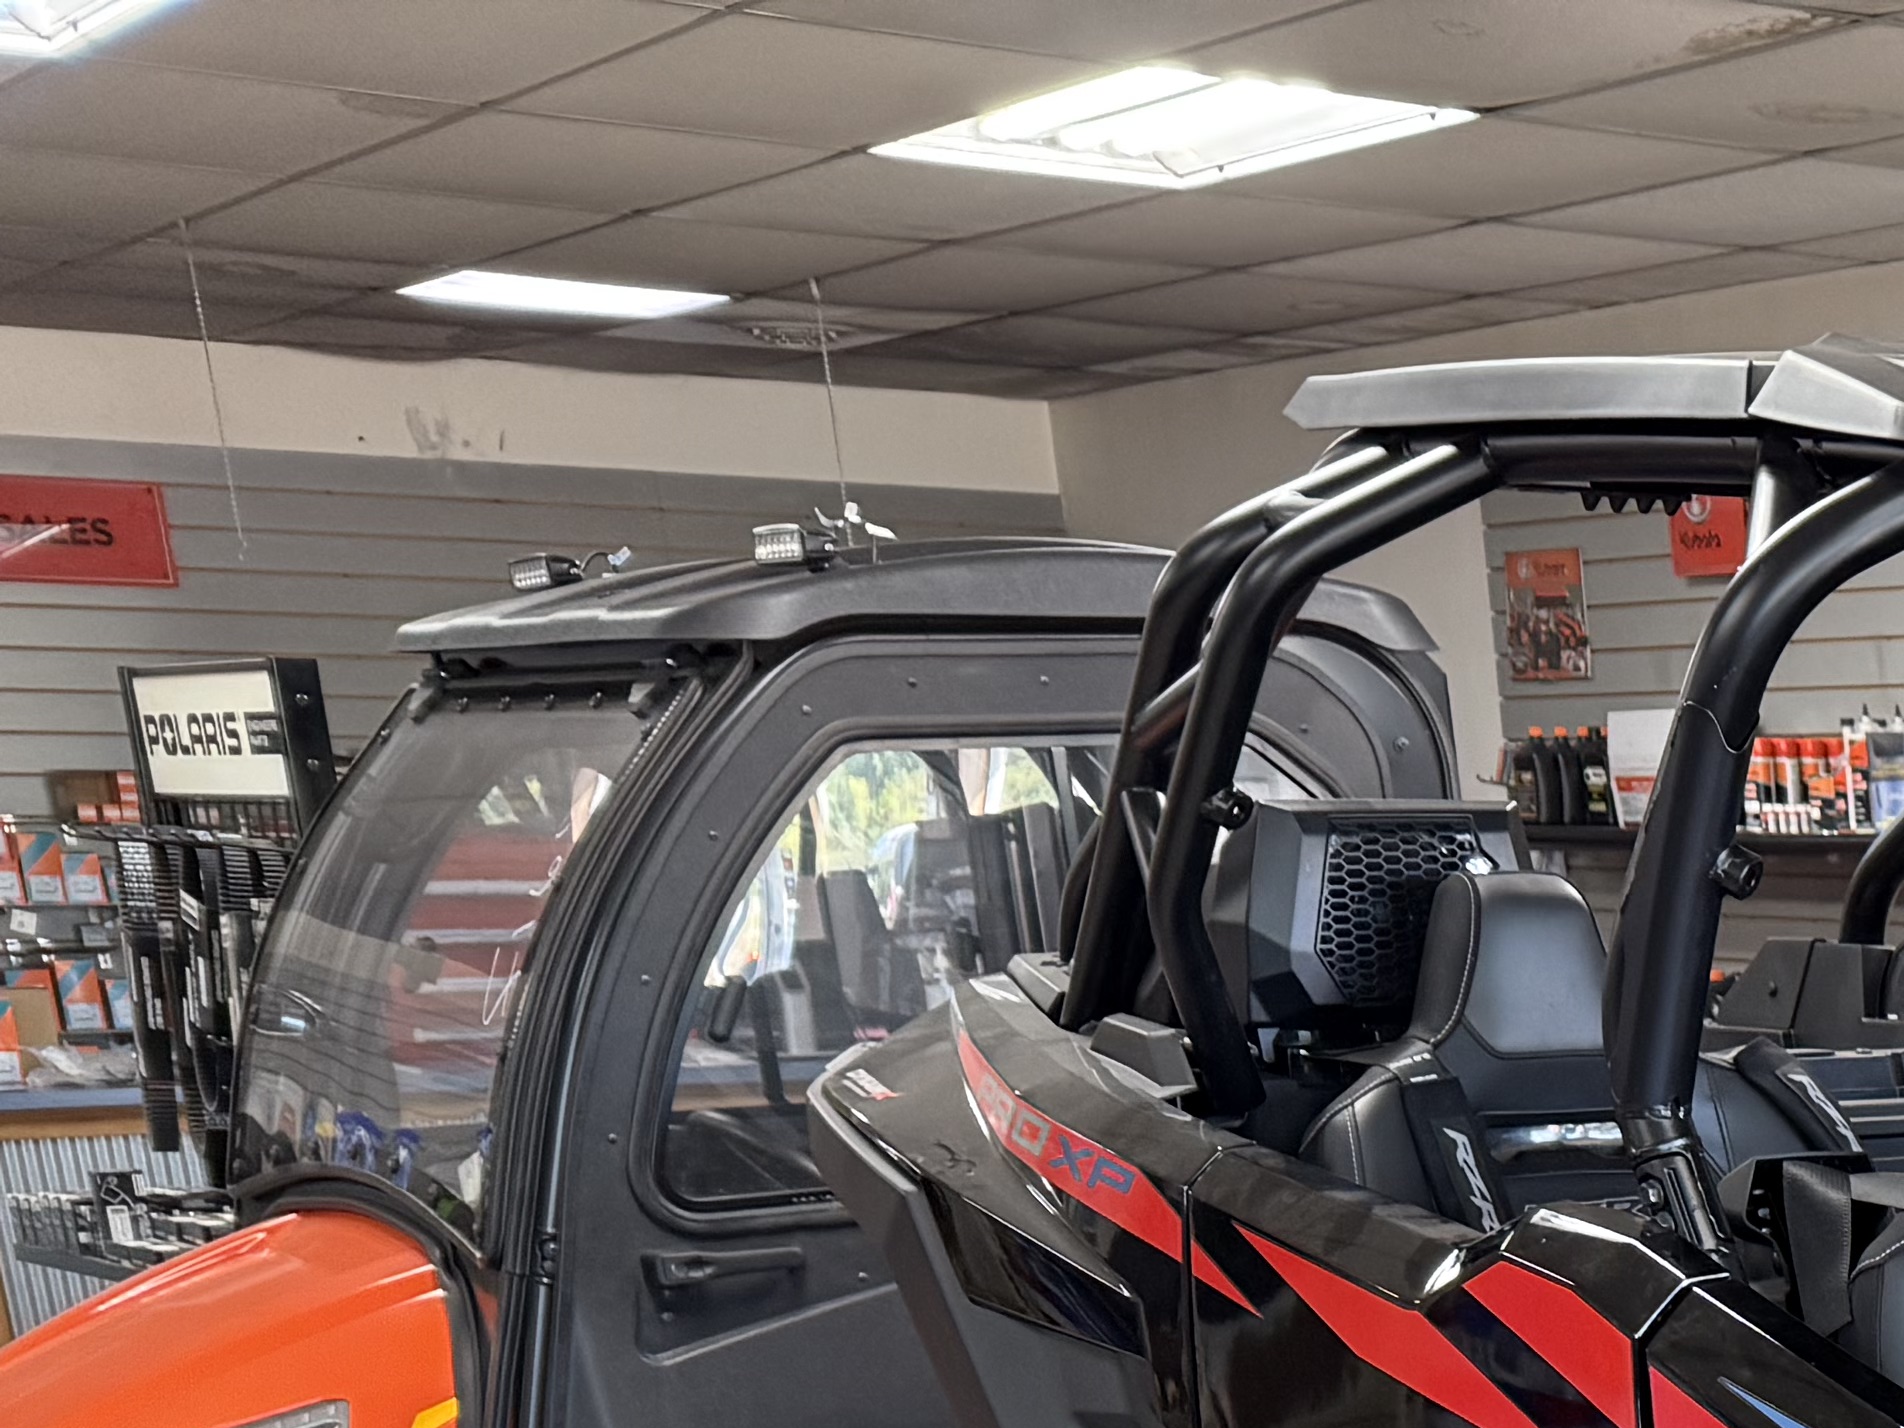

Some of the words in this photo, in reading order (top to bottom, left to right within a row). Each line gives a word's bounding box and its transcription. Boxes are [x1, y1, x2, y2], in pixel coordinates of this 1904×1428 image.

[143, 711, 243, 757] POLARIS
[1049, 1135, 1137, 1194] XP
[1442, 1127, 1501, 1234] RZR
